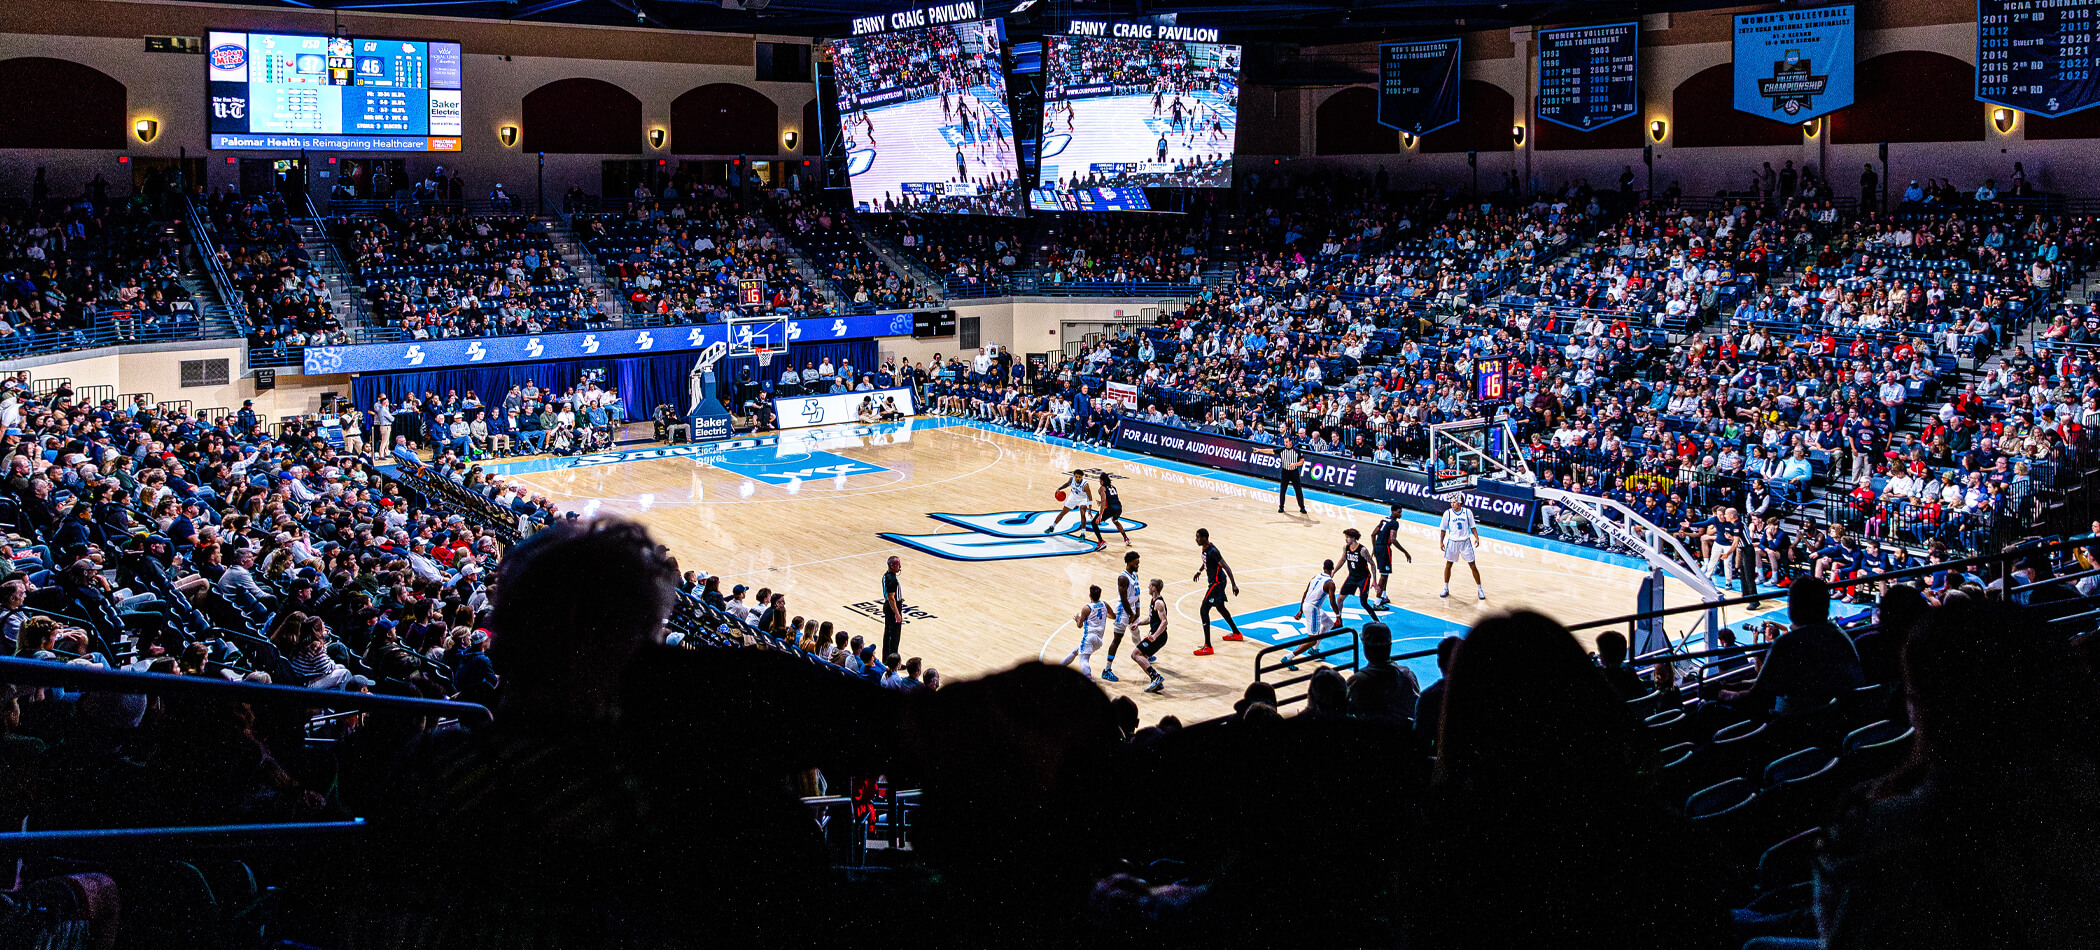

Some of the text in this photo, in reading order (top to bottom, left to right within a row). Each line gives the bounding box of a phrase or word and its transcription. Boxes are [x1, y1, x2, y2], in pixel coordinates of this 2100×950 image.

[2004, 2, 2032, 10] NCAA
[852, 2, 976, 35] JENNY CRAIG PAVILION
[1741, 8, 1847, 24] WOMEN'S VOLLEYBALL
[1983, 15, 2008, 24] 2011
[2032, 12, 2044, 21] RD
[1805, 19, 1850, 28] SEMIFINALIST
[1068, 20, 1218, 42] JENNY CRAIG PAVILION
[1549, 27, 1628, 40] WOMEN'S VOLLEYBALL
[1983, 26, 2008, 36] 2012
[1575, 36, 1620, 46] TOURNAMENT
[1983, 39, 2008, 48] 2013
[2060, 34, 2090, 44] 2020
[302, 40, 320, 49] USD
[364, 42, 378, 52] GU
[1411, 44, 1448, 52] BASKETBALL
[212, 49, 242, 58] Jersey
[1983, 51, 2008, 59] 2014
[2060, 46, 2088, 56] 2021
[304, 58, 319, 71] 37
[362, 60, 380, 73] 46
[1982, 63, 2008, 72] 2015
[2031, 61, 2043, 70] RD
[2060, 58, 2089, 68] 2022
[1982, 75, 2008, 83] 2016
[1764, 80, 1823, 92] CHAMPIONSHIP
[1982, 87, 2006, 95] 2017
[2030, 86, 2043, 94] RD
[432, 100, 460, 108] Baker
[213, 103, 245, 118] U-T
[221, 137, 264, 147] Palomar
[267, 138, 300, 147] Health
[312, 139, 370, 149] Reimagining
[926, 184, 933, 193] 46
[946, 184, 952, 192] 37
[748, 289, 759, 302] 16
[1479, 360, 1499, 374] 47.7
[1487, 374, 1501, 397] 16
[1108, 388, 1136, 404] ESPN
[695, 418, 727, 428] Baker
[695, 427, 727, 437] Electric
[1123, 428, 1282, 469] FOR ALL YOUR AUDIOVISUAL NEEDS
[1301, 460, 1357, 487] FORTÉ
[1610, 528, 1628, 543] SAN
[1626, 538, 1646, 554] DIEGO
